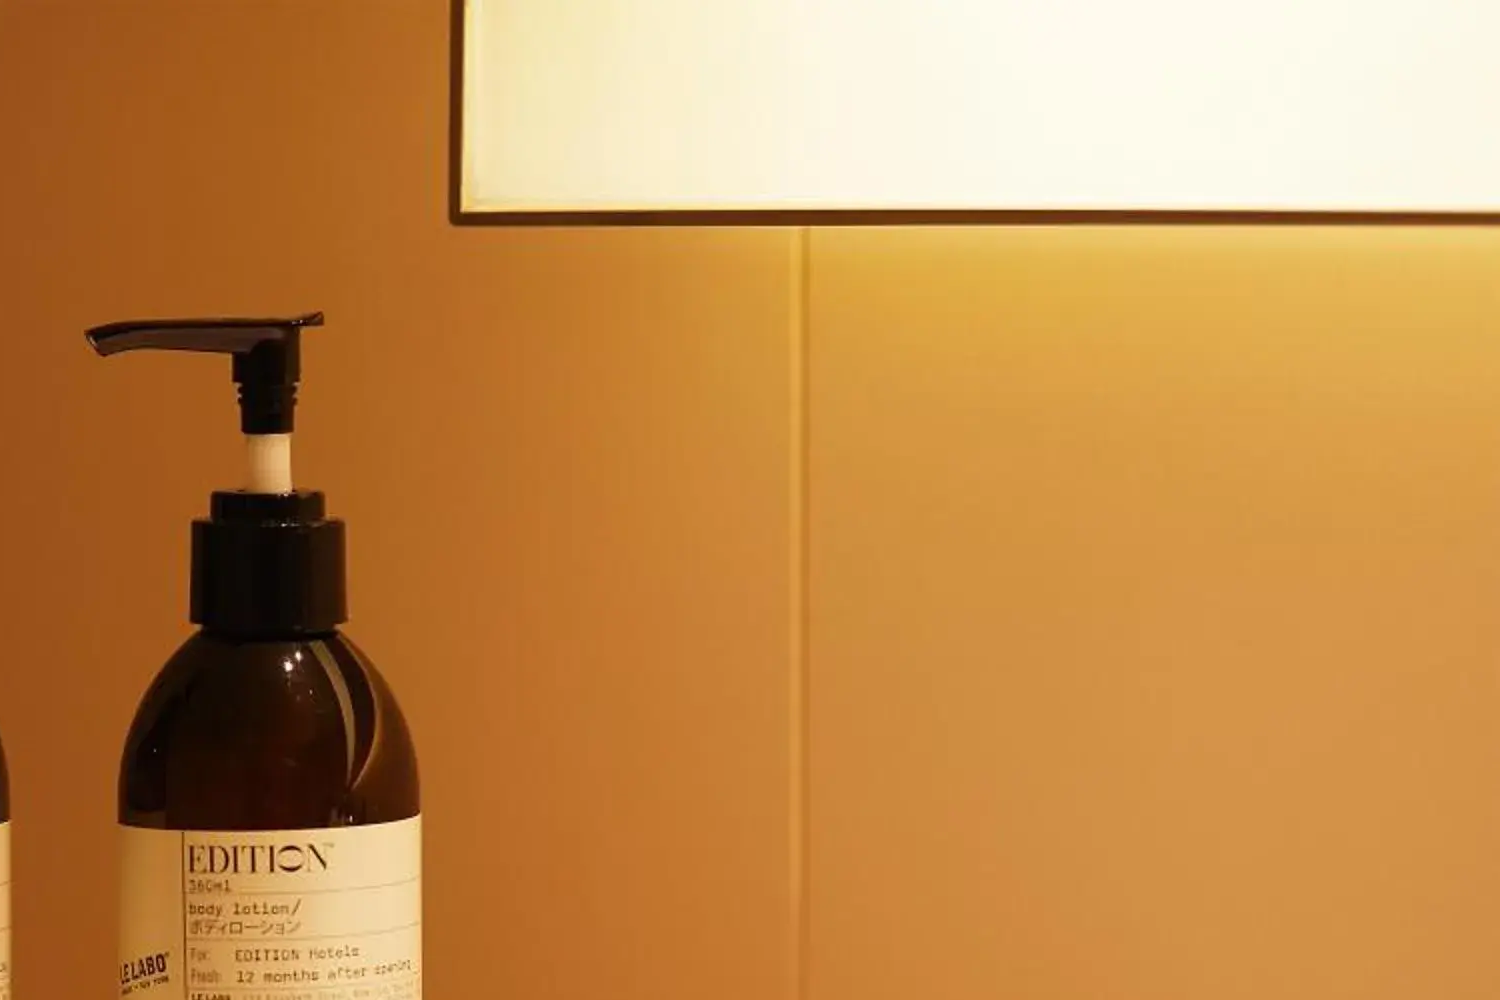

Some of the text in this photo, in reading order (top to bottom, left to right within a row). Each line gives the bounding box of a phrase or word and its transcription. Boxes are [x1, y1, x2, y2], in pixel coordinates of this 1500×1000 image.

[189, 844, 327, 874] EDITION
[189, 903, 222, 918] body
[190, 920, 301, 936] ボディローション
[235, 950, 299, 961] EDITION
[309, 947, 360, 960] Hotels
[236, 970, 254, 982] 12
[263, 969, 318, 982] months
[328, 966, 368, 980] after
